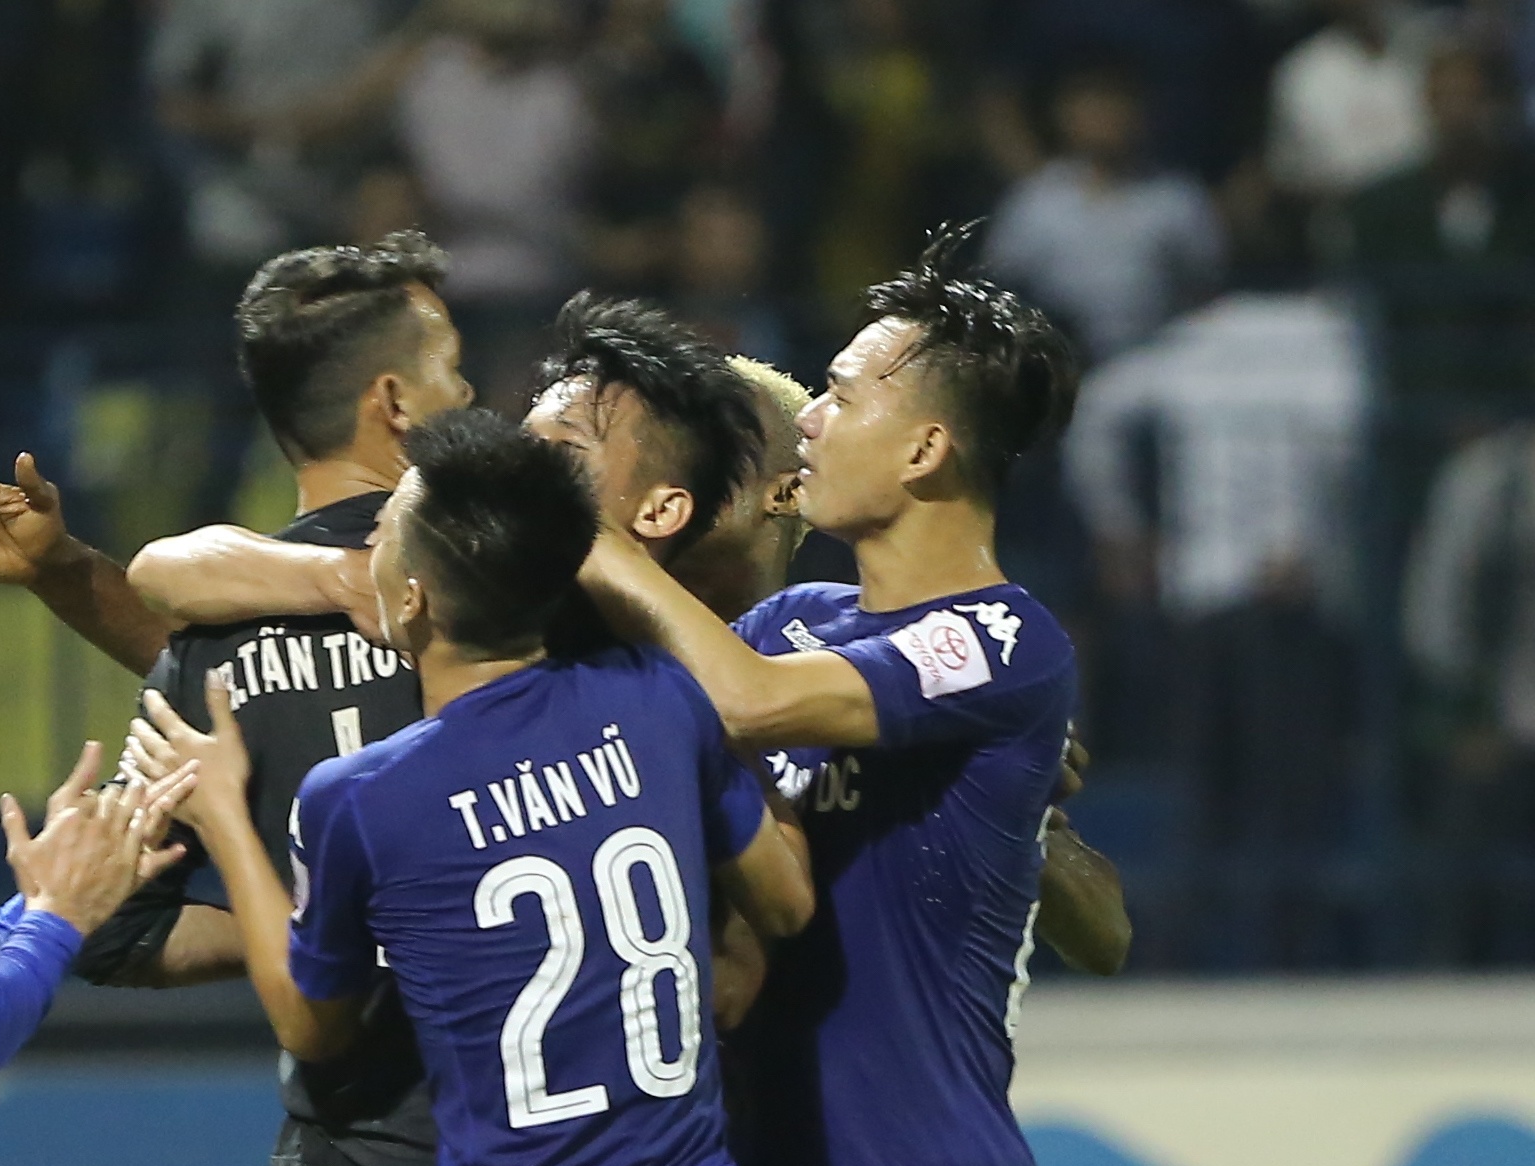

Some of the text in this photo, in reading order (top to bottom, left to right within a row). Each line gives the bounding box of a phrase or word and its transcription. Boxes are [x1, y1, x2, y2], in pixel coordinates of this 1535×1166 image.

[448, 722, 641, 849] T.VĂN VŨ
[473, 826, 700, 1128] 28
